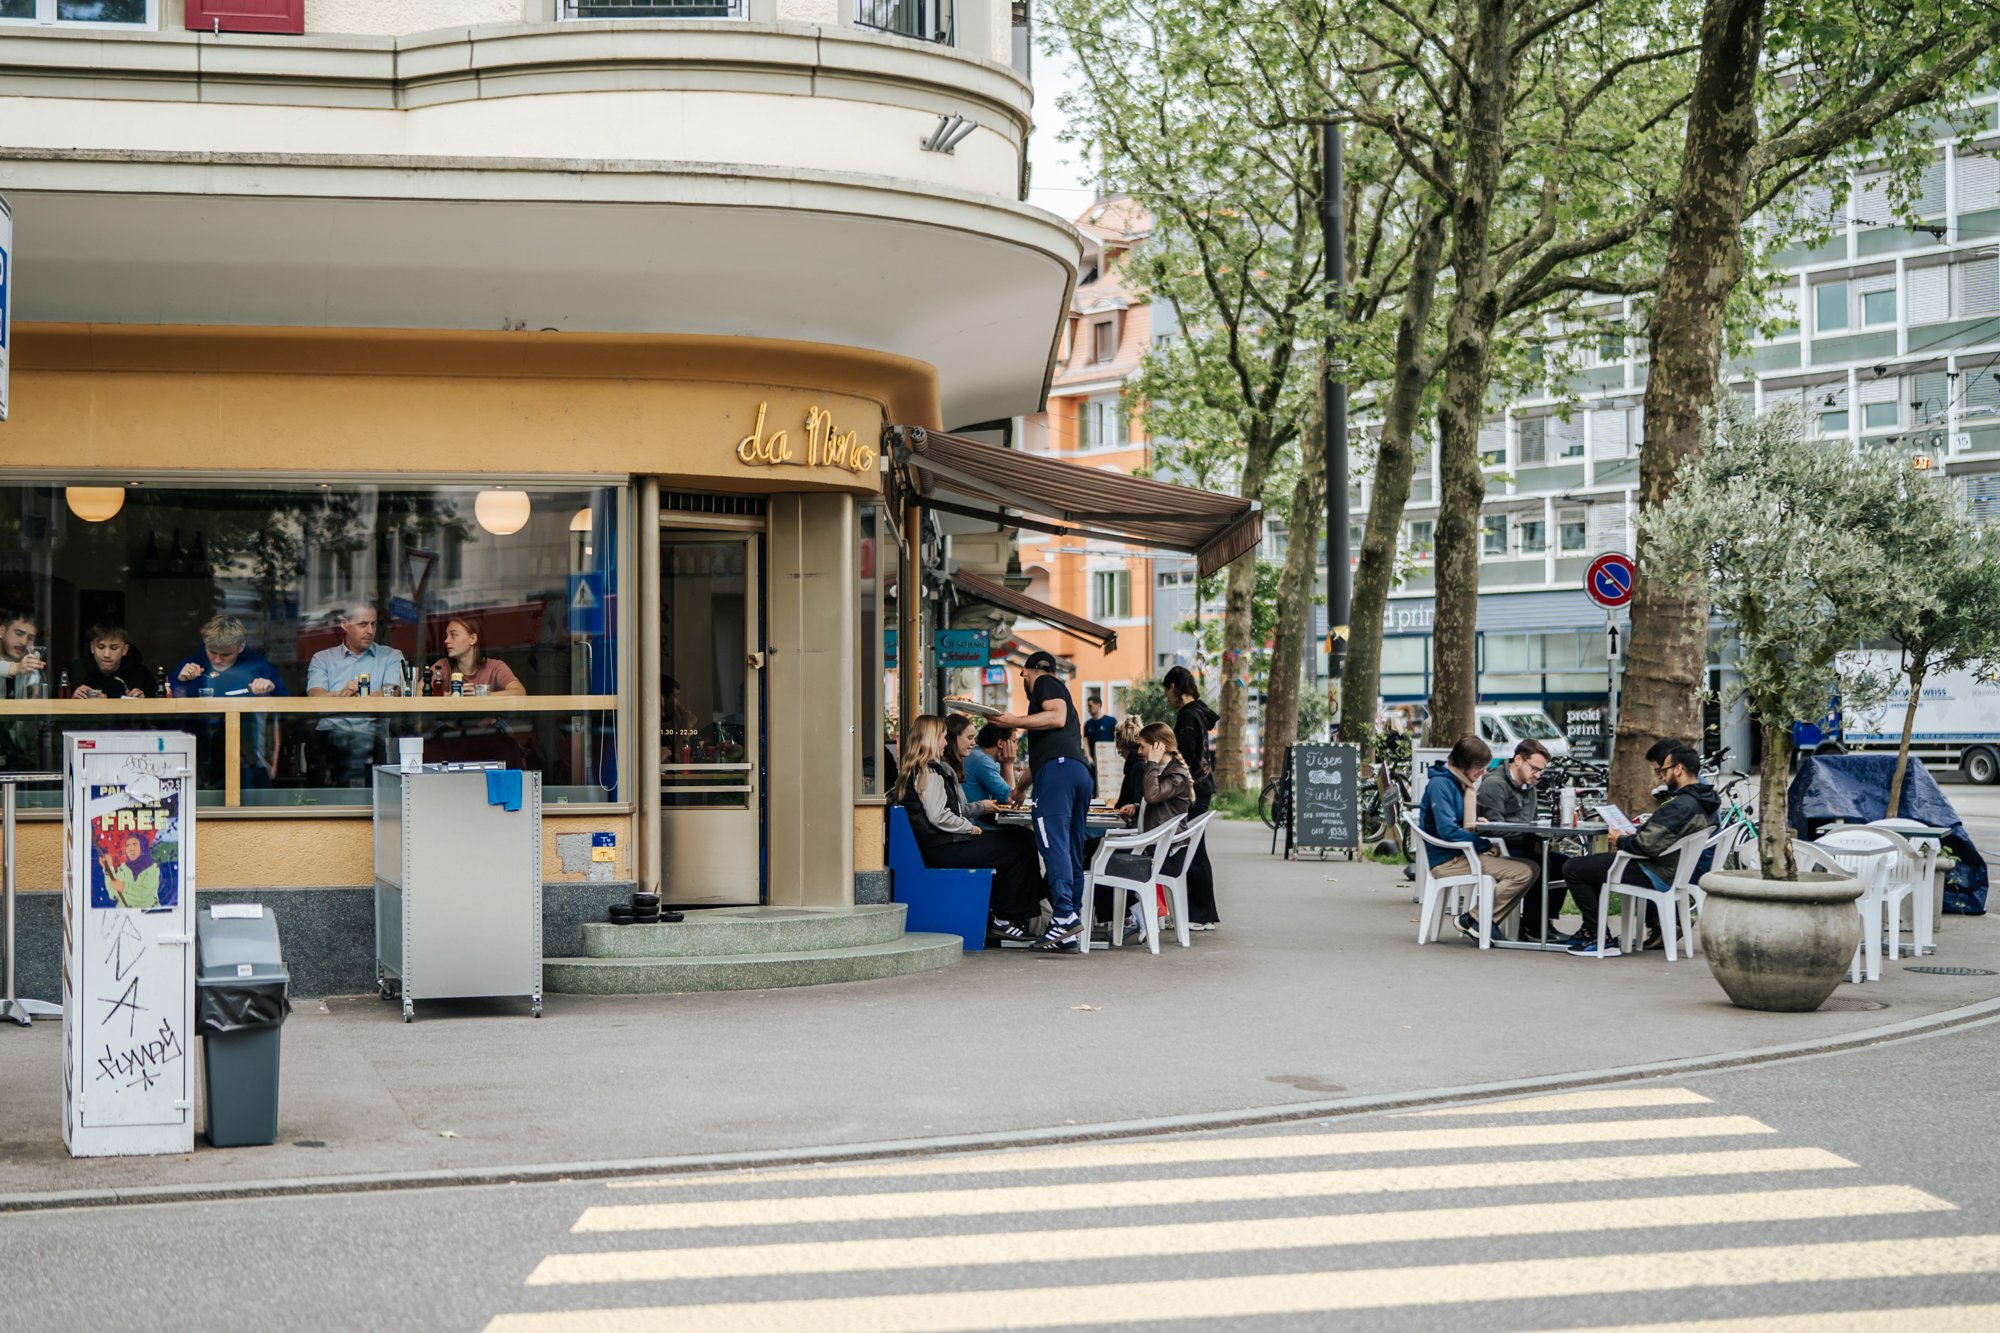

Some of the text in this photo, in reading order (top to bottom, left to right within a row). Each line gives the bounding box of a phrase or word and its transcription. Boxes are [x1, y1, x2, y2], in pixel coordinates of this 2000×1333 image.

[738, 401, 877, 471] da Nino
[1957, 436, 1969, 447] 15
[1397, 603, 1436, 633] prin
[1923, 687, 1947, 697] WEISS
[1566, 708, 1600, 723] proki
[1567, 723, 1600, 737] print
[1305, 751, 1343, 768] Tiger
[101, 809, 170, 832] FREE
